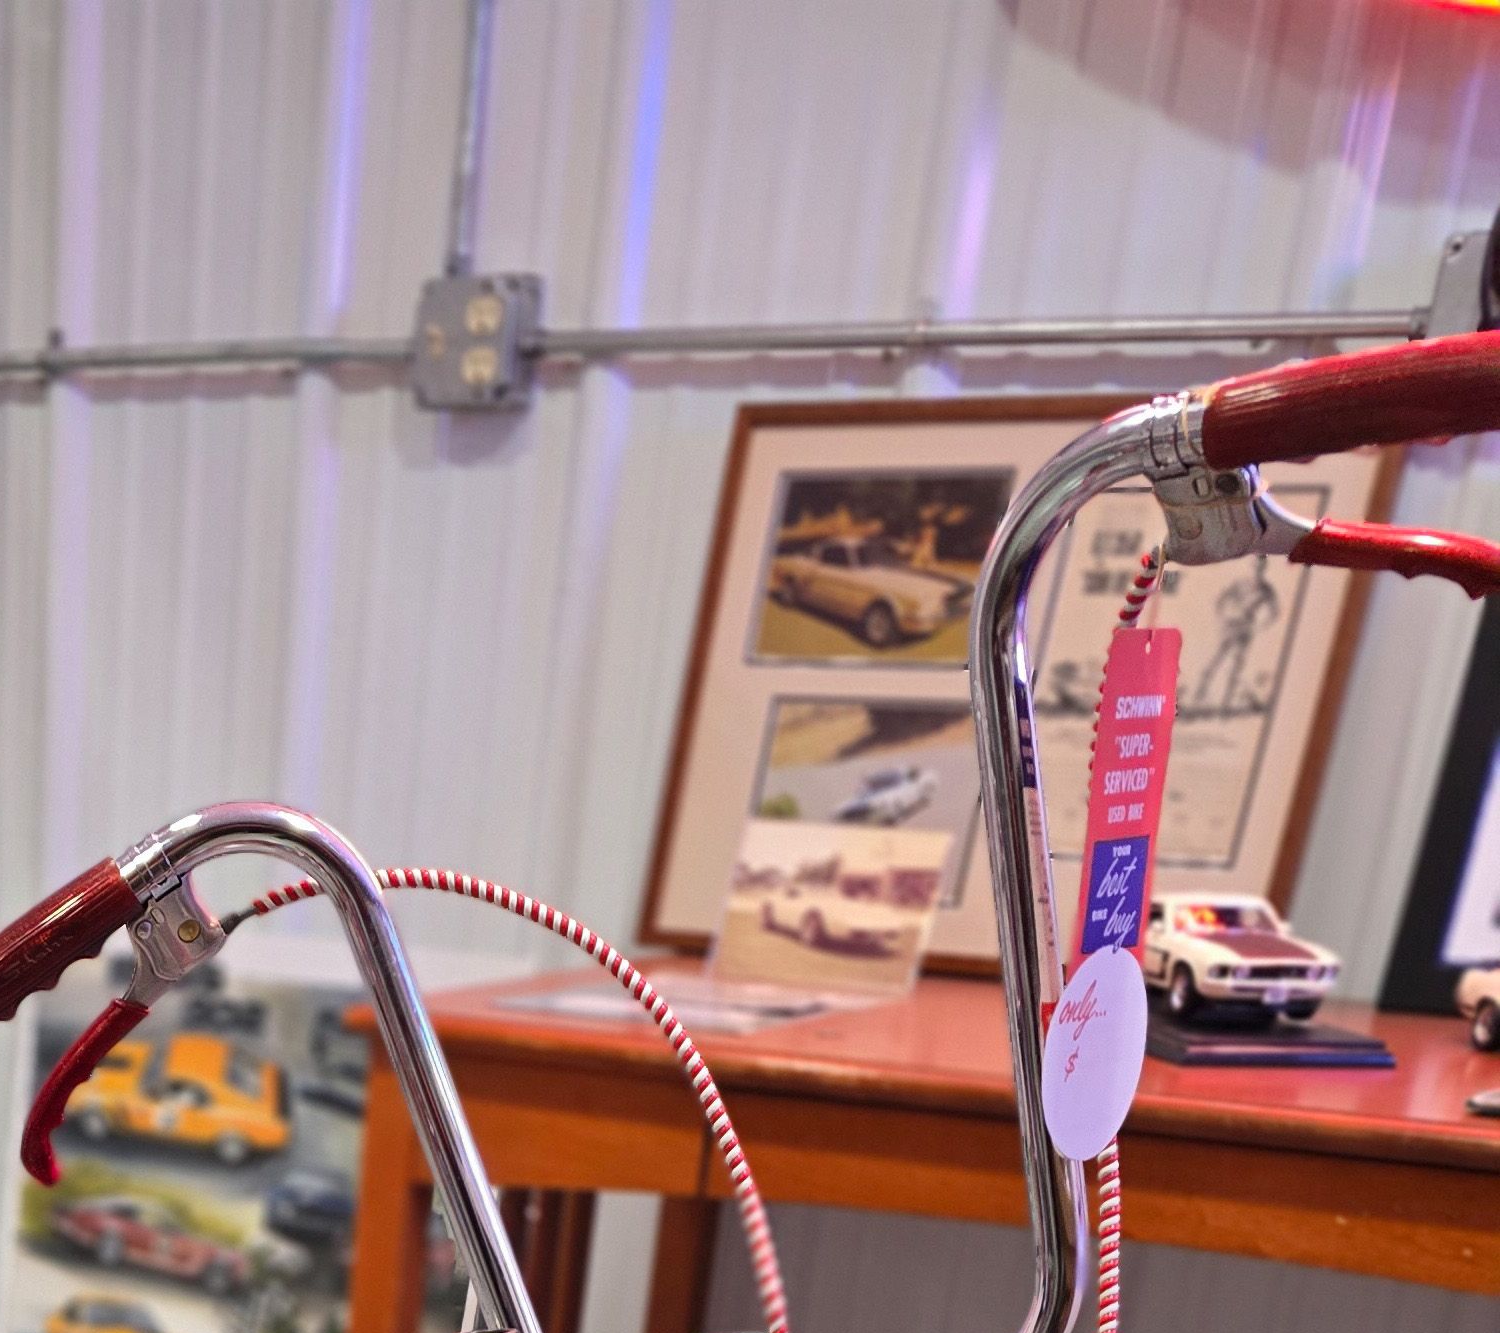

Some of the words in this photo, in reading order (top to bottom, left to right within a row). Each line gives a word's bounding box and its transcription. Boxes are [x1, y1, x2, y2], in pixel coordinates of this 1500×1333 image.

[1115, 695, 1162, 720] SCHWINN
[1107, 804, 1126, 824] USED
[1127, 802, 1145, 822] BIKE
[1112, 845, 1132, 858] YOUR
[1096, 857, 1138, 898] best
